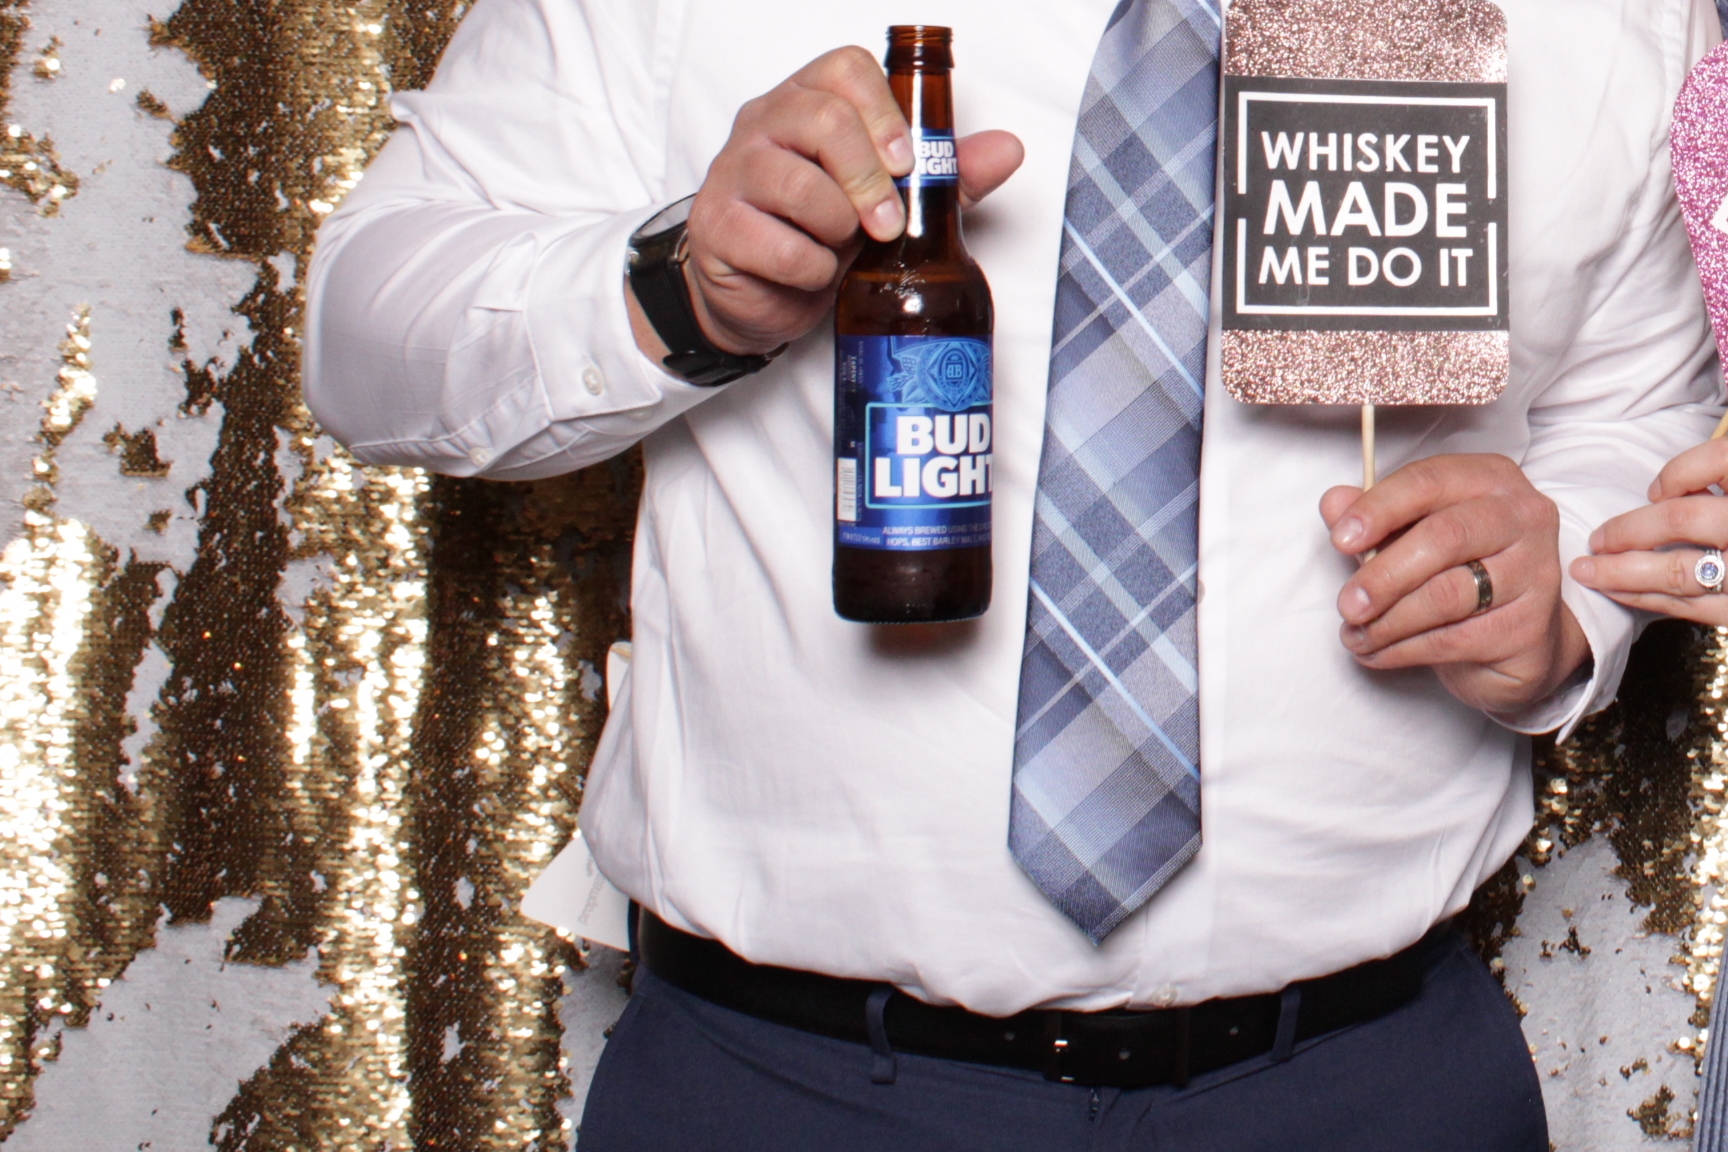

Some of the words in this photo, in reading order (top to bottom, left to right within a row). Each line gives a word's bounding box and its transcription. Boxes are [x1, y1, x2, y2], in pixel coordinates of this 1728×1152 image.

[918, 141, 954, 158] BUD
[1261, 130, 1471, 174] WHISKEY
[1263, 180, 1469, 238] MADE
[1258, 245, 1330, 286] ME
[1348, 246, 1423, 287] DO
[1440, 247, 1474, 288] IT
[896, 413, 991, 455] BUD
[874, 453, 993, 498] LIGHT
[883, 525, 914, 536] ALWAYS
[914, 524, 947, 535] BREWED
[911, 535, 931, 546] BEST
